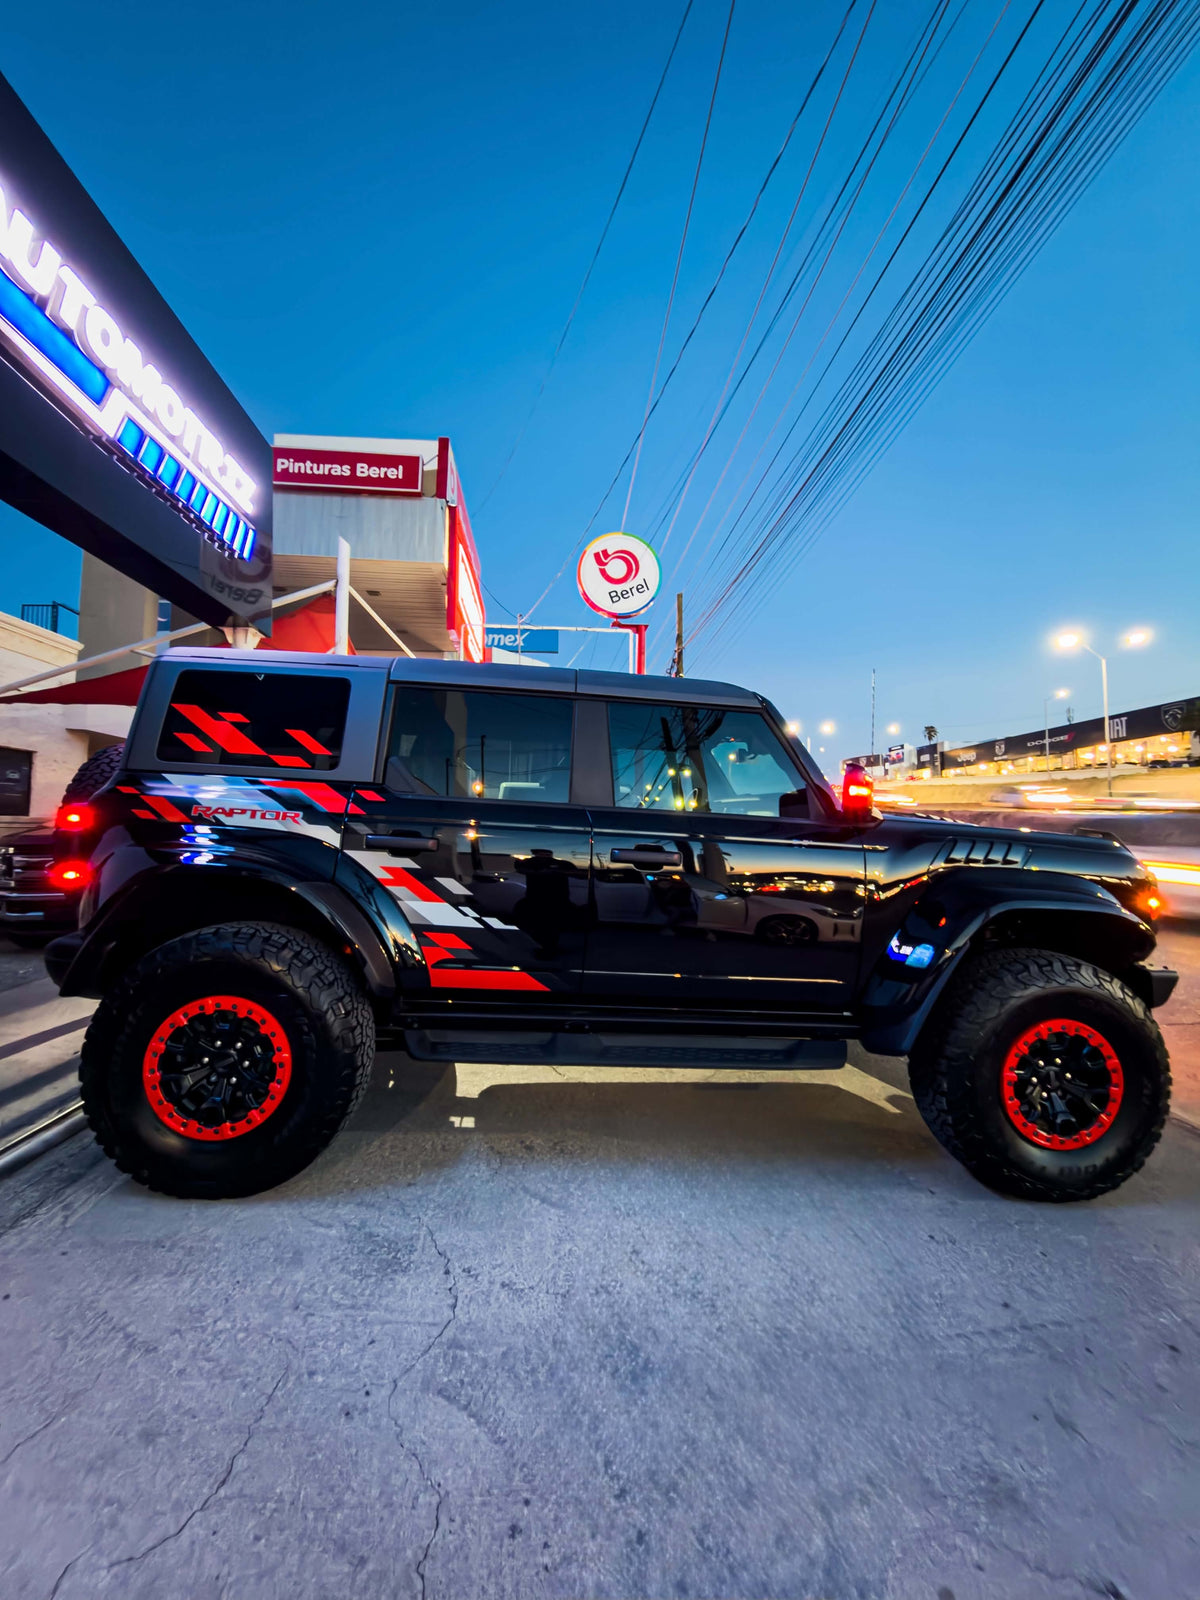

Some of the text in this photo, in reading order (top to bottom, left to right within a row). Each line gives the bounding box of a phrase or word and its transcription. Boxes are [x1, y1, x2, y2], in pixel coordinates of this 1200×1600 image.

[276, 458, 403, 480] Pinturas Berel
[608, 578, 650, 604] Berel
[485, 631, 531, 647] mex
[1109, 716, 1128, 740] IAT
[191, 804, 304, 826] RAPTOR
